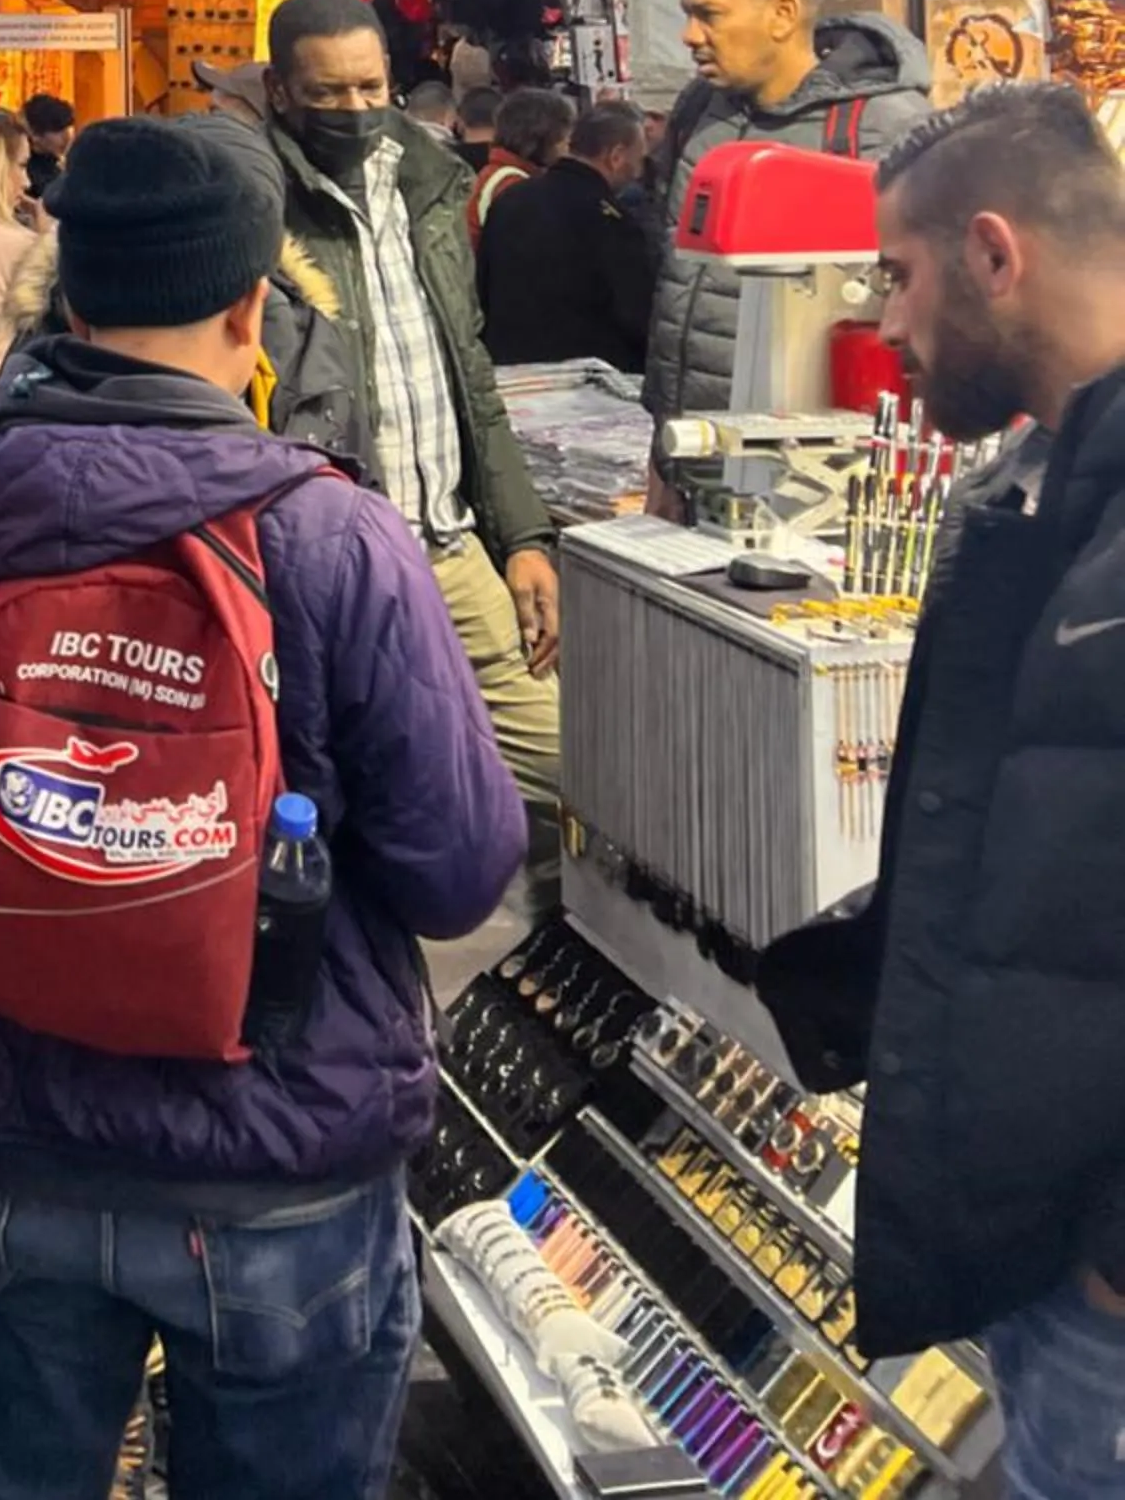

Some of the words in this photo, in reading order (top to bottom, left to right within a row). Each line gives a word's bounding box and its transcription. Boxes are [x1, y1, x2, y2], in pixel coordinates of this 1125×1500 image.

[16, 663, 129, 691] CORPORATION
[50, 631, 102, 659] IBC
[106, 634, 206, 685] TOURS
[28, 789, 95, 838] IBC
[92, 824, 233, 850] TOURS.COM
